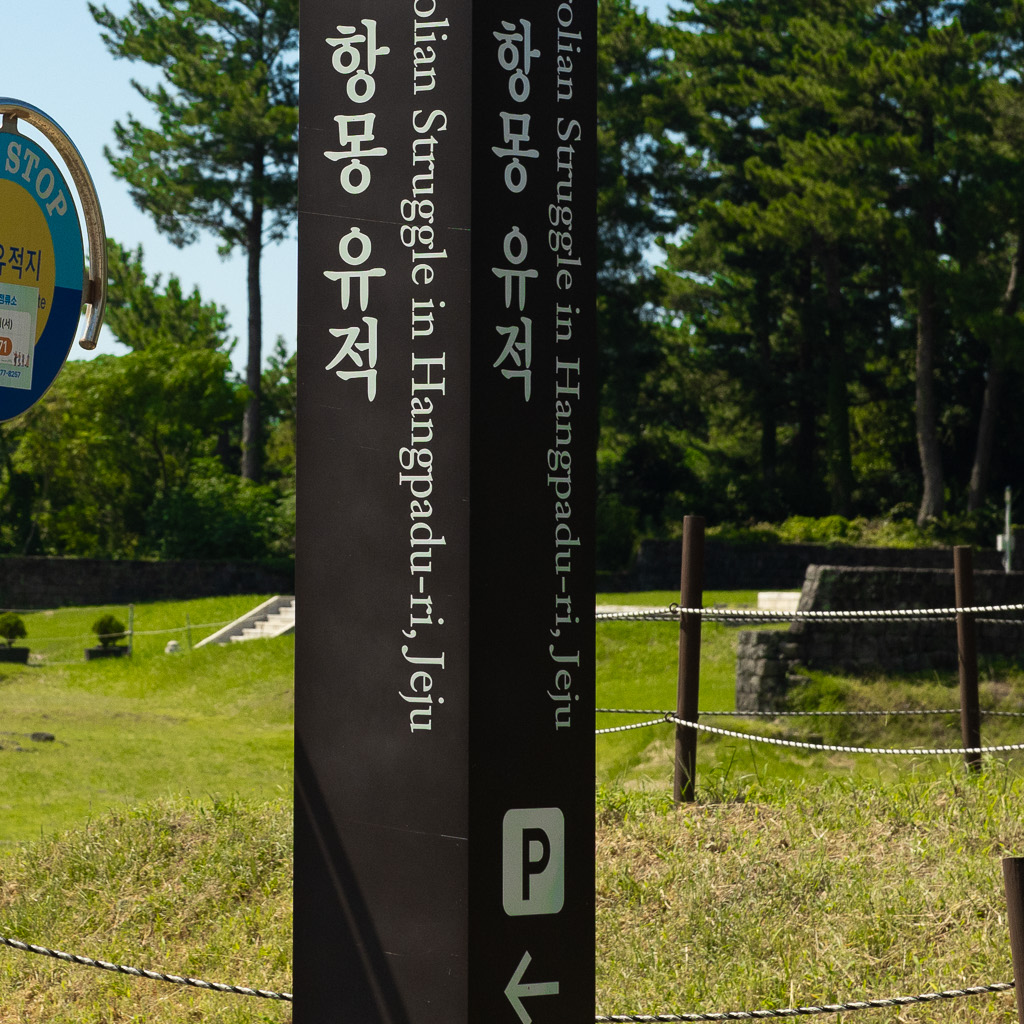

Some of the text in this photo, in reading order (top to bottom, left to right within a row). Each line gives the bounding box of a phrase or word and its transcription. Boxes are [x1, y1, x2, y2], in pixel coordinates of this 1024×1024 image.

[323, 18, 391, 195] 항몽
[491, 18, 541, 194] 항몽
[5, 140, 67, 217] STOP
[399, 109, 448, 286] Struggle
[547, 117, 582, 290] Struggle
[322, 226, 387, 403] 유적
[411, 297, 446, 340] in
[491, 225, 539, 402] 유적
[555, 302, 581, 344] in
[399, 644, 445, 734] Jeju
[546, 643, 580, 731] Jeju
[522, 827, 550, 901] P
